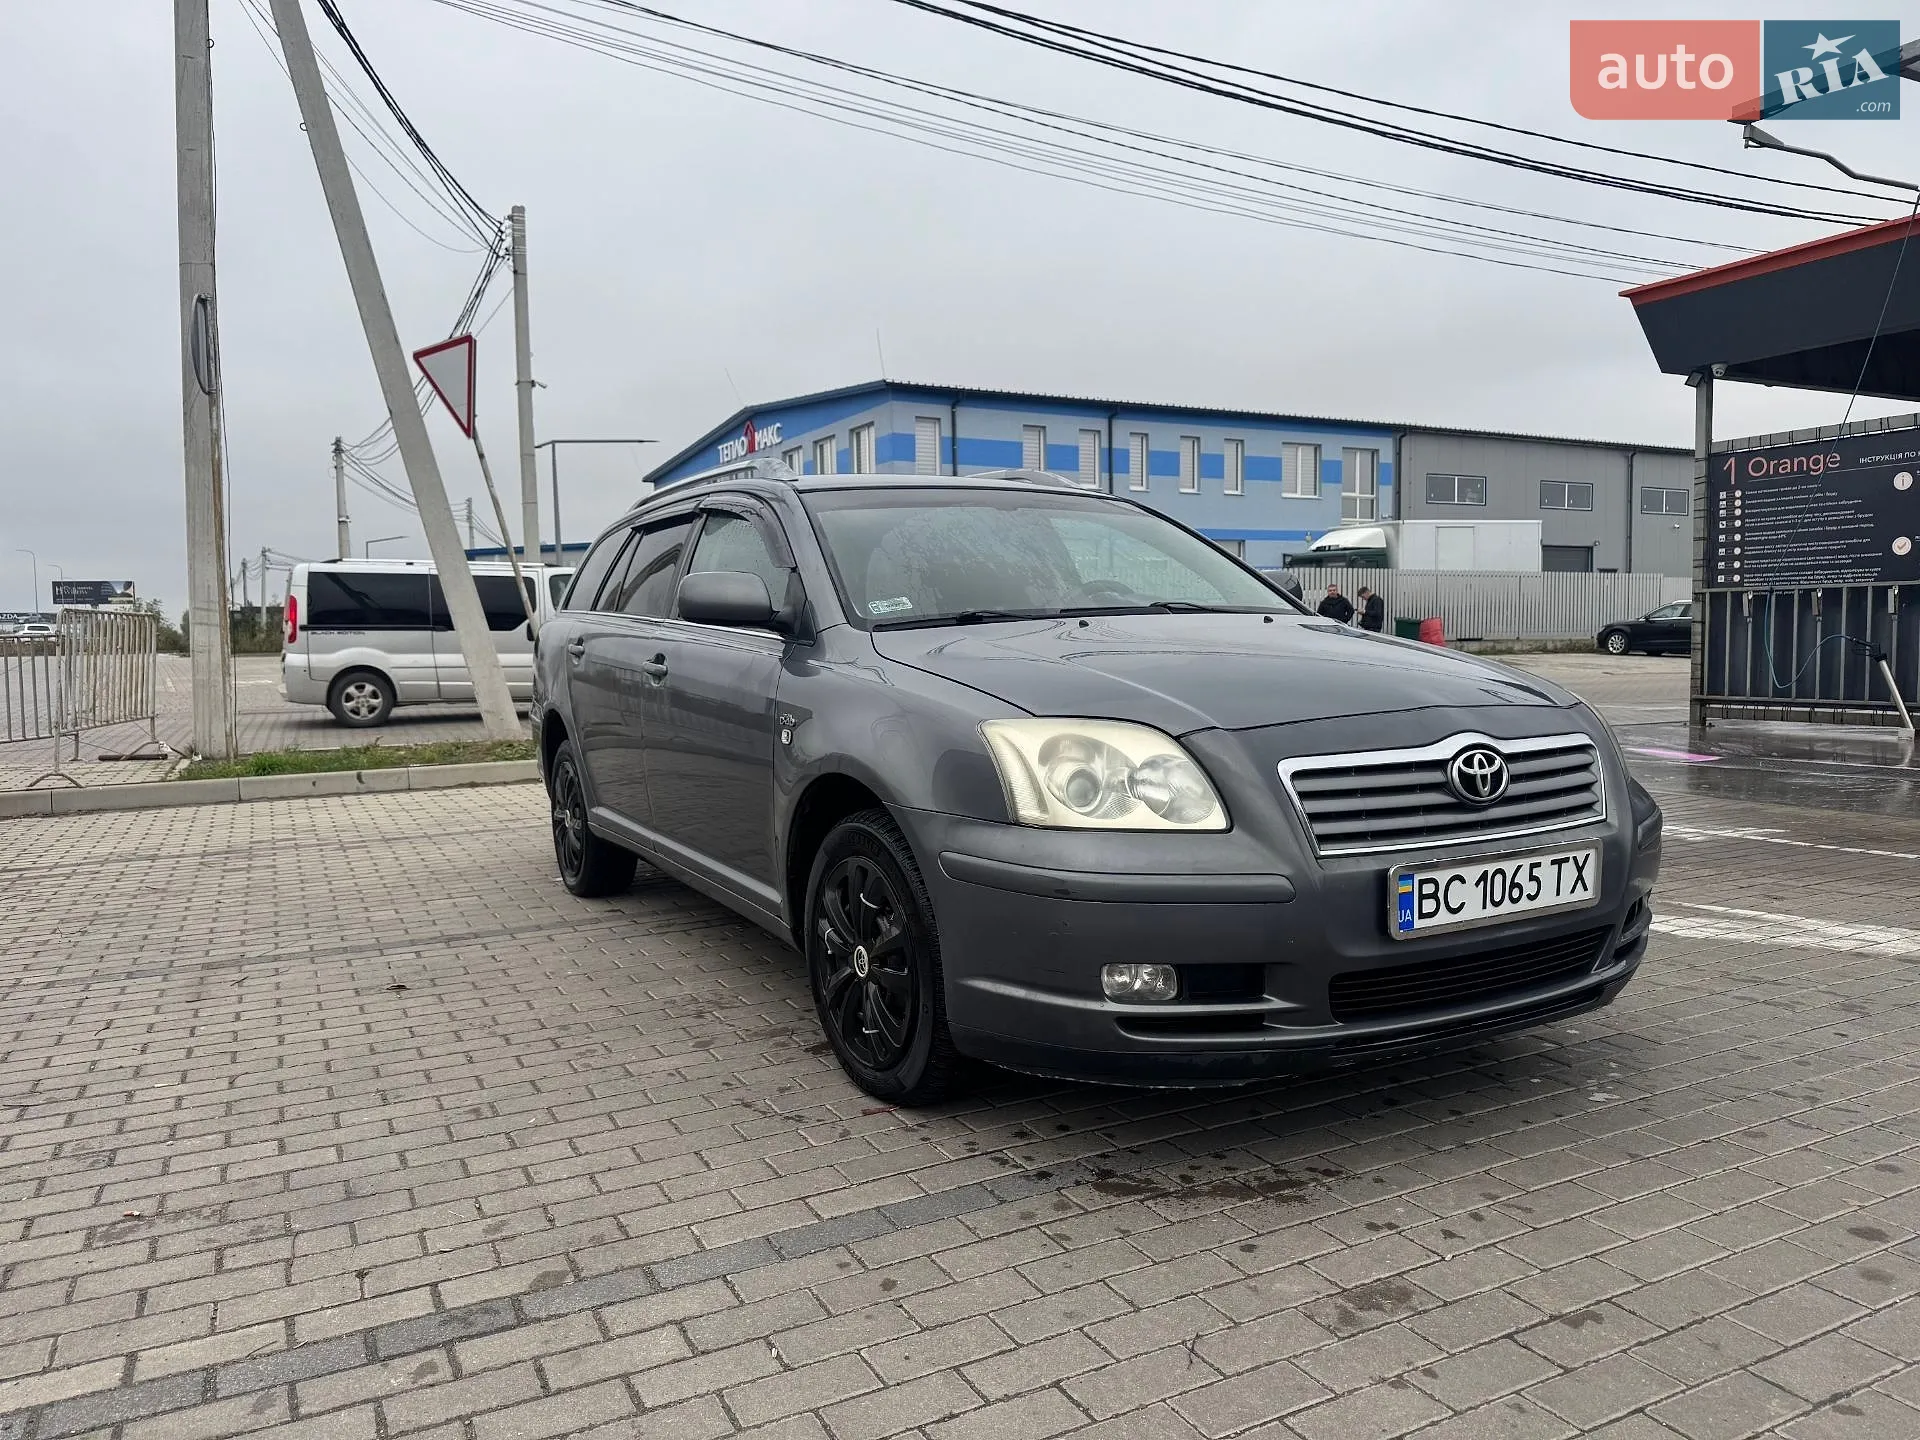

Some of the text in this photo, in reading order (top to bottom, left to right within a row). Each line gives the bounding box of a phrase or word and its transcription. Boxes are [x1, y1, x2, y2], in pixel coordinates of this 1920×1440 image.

[717, 422, 783, 464] ТЕПЛО МАКС
[1859, 452, 1903, 464] ІНСТРУКЦІЯ
[1904, 450, 1916, 459] ПО
[1723, 453, 1841, 485] 1 Orange
[1417, 852, 1591, 920] BC 1065 TX
[1398, 908, 1413, 923] UA
